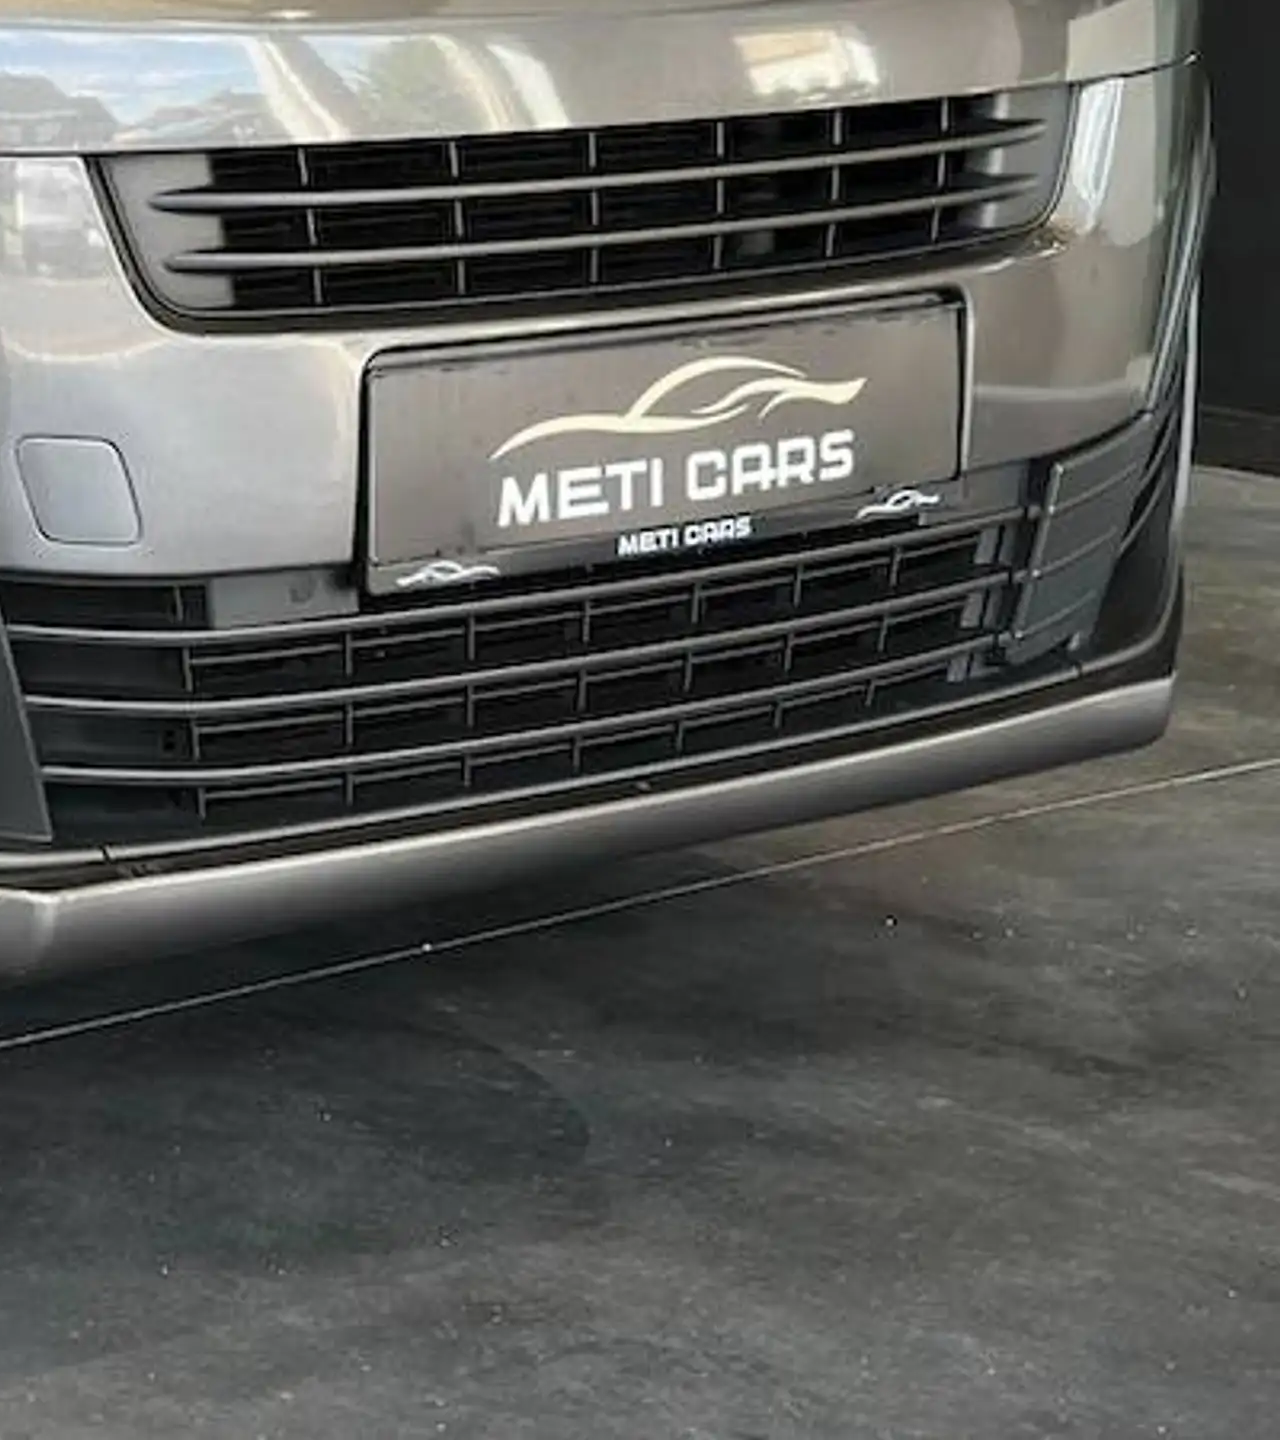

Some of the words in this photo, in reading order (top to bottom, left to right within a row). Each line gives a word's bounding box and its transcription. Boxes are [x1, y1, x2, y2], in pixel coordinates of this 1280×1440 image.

[498, 458, 663, 527] METI
[687, 428, 854, 500] CARS
[617, 527, 679, 556] METI
[684, 516, 752, 546] CARS
